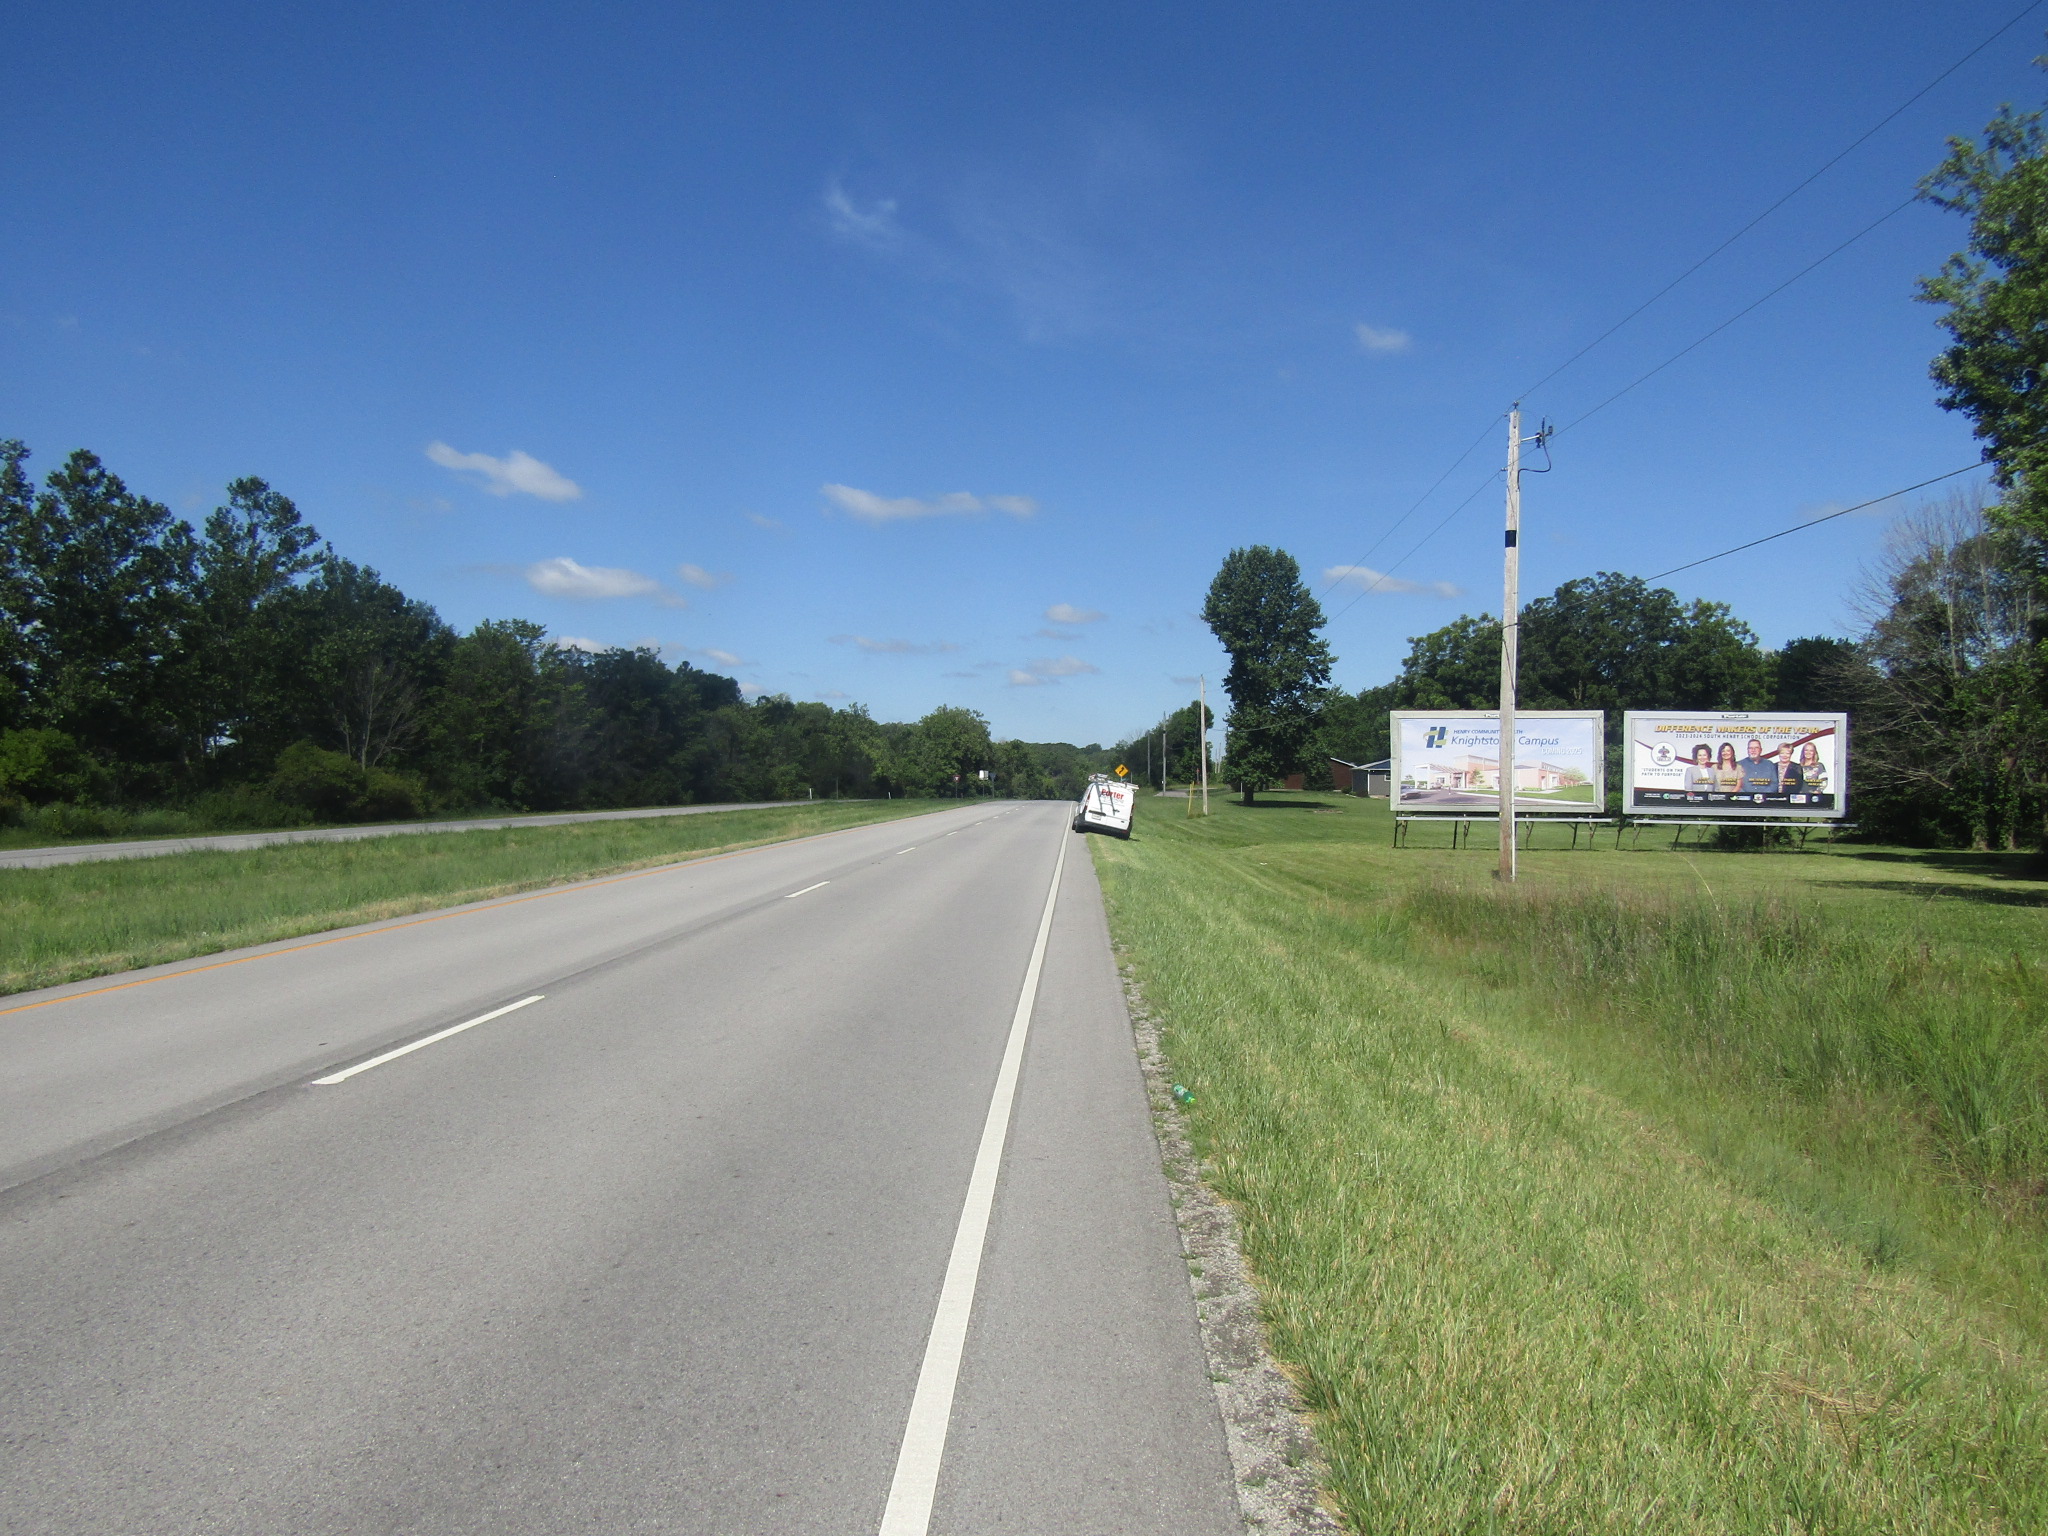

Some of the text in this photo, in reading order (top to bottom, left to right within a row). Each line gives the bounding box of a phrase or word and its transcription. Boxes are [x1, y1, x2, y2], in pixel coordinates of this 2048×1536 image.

[1654, 725, 1820, 735] DIFFERENCE MAKERS OF THE YEAR
[1451, 736, 1559, 747] Knightsto Campus
[1101, 788, 1124, 800] Porter
